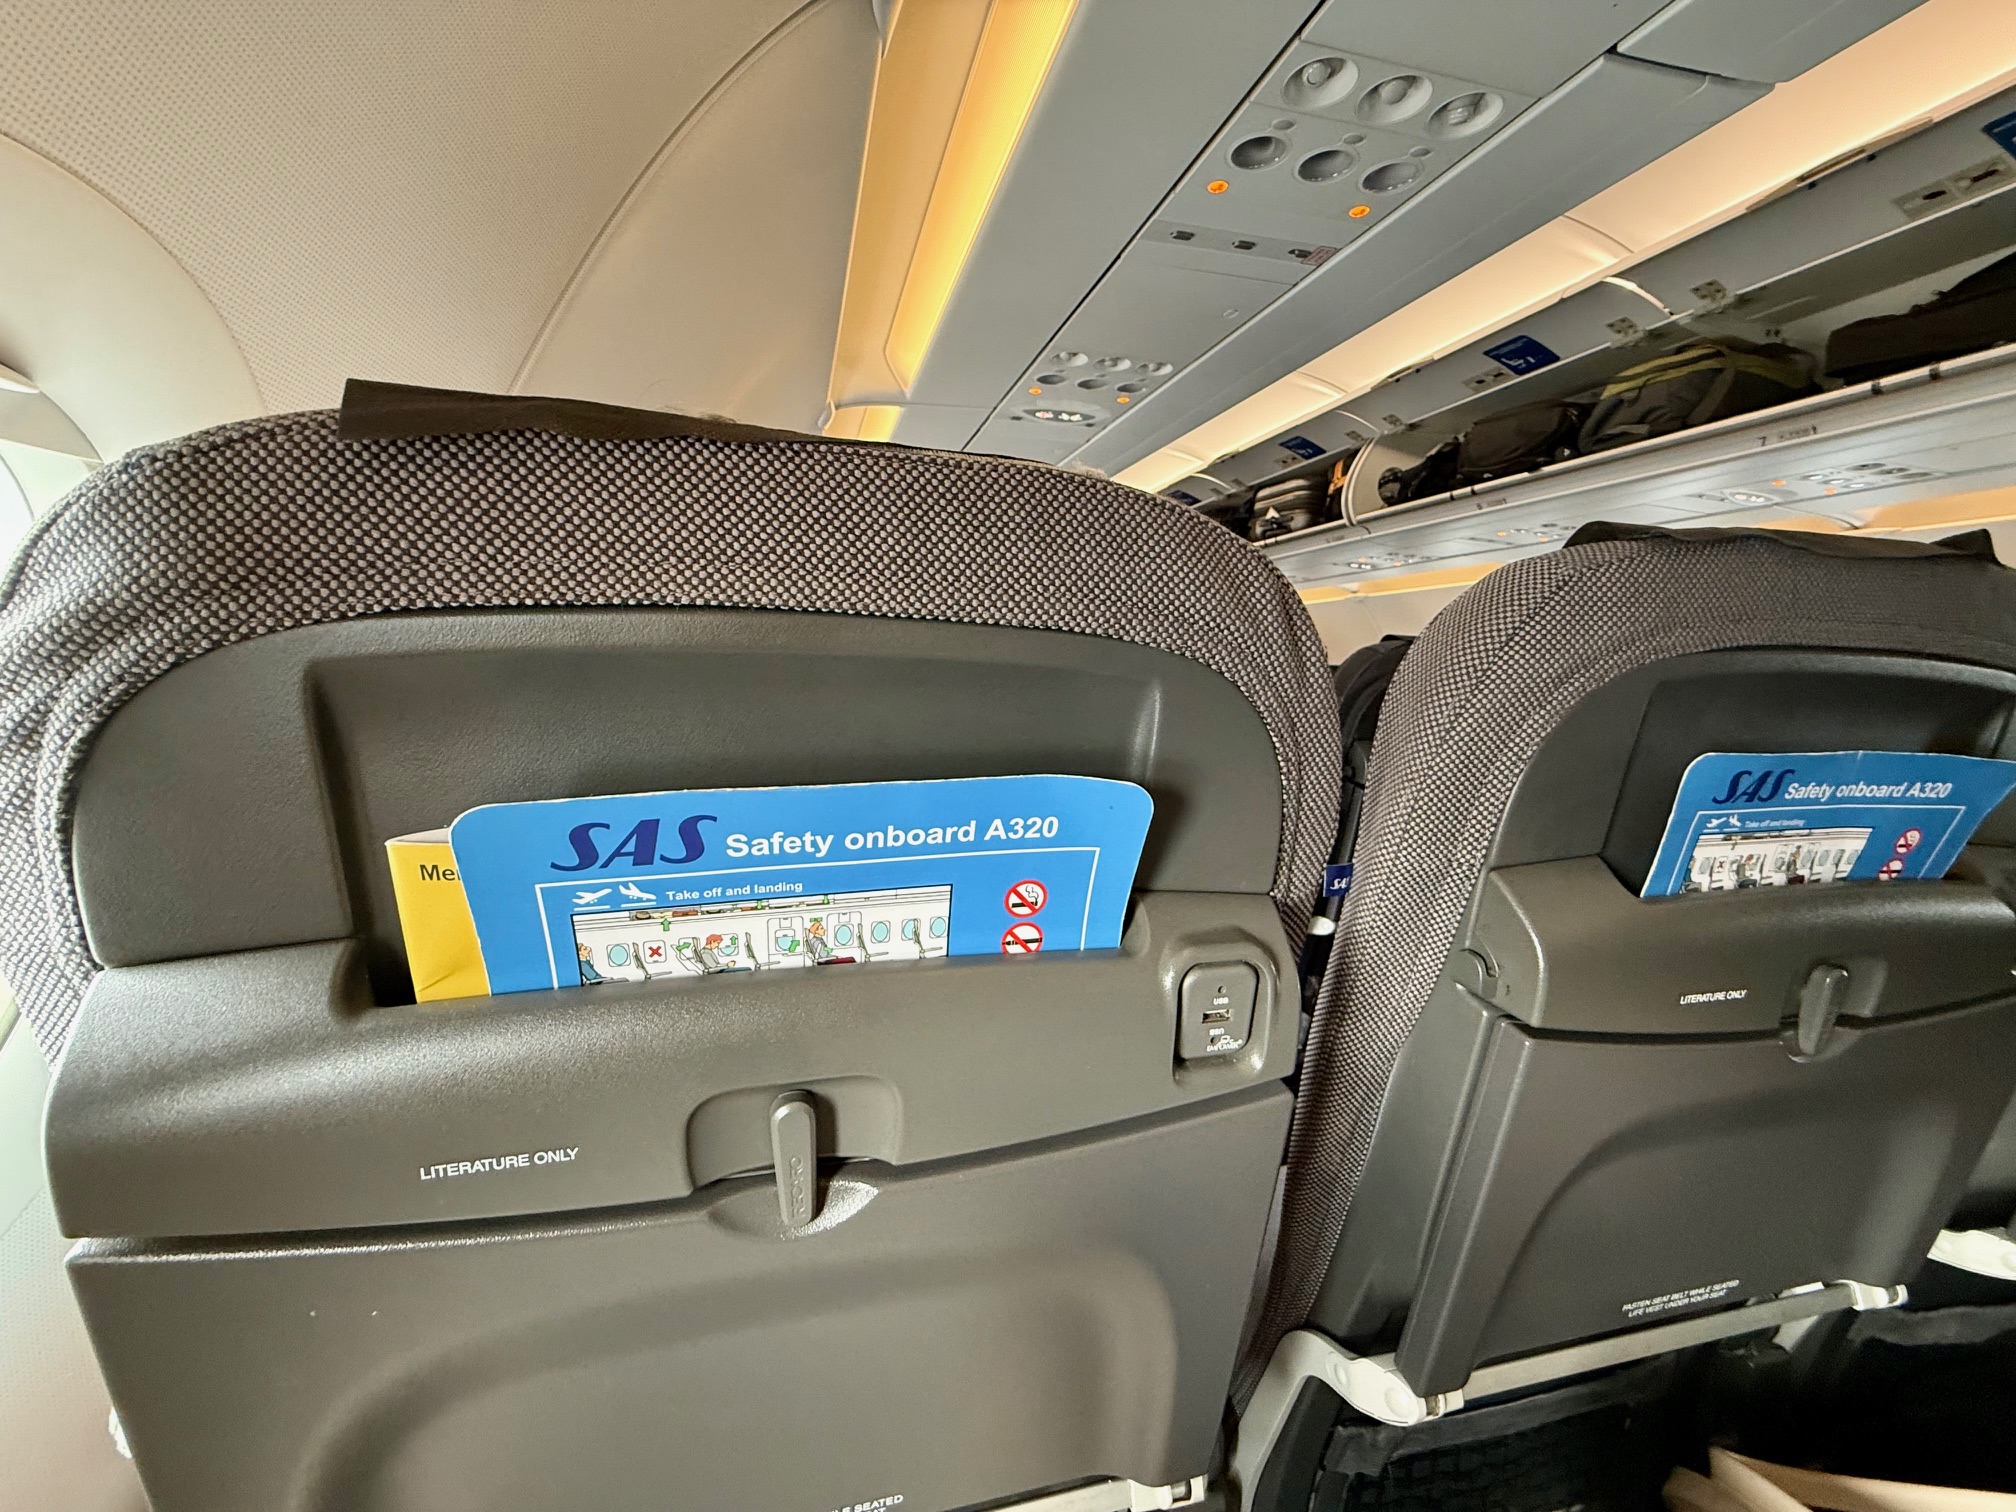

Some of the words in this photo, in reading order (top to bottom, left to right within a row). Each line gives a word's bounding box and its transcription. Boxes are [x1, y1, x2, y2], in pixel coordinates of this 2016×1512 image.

[1712, 768, 1796, 804] SAS
[1784, 781, 1836, 802] Safety
[1836, 781, 1907, 798] onboard
[1908, 782, 1953, 798] A320
[550, 814, 718, 872] SAS
[725, 830, 835, 858] Safety
[844, 820, 977, 850] onboard
[983, 816, 1059, 841] A320
[665, 889, 700, 901] Take
[703, 887, 722, 898] off
[725, 884, 751, 896] and
[754, 882, 803, 894] landing
[1679, 991, 1727, 1005] LITERATURE
[1726, 989, 1748, 1000] ONLY
[420, 1153, 531, 1181] LITERATURE
[533, 1147, 579, 1165] ONLY
[853, 1494, 904, 1512] SEATED
